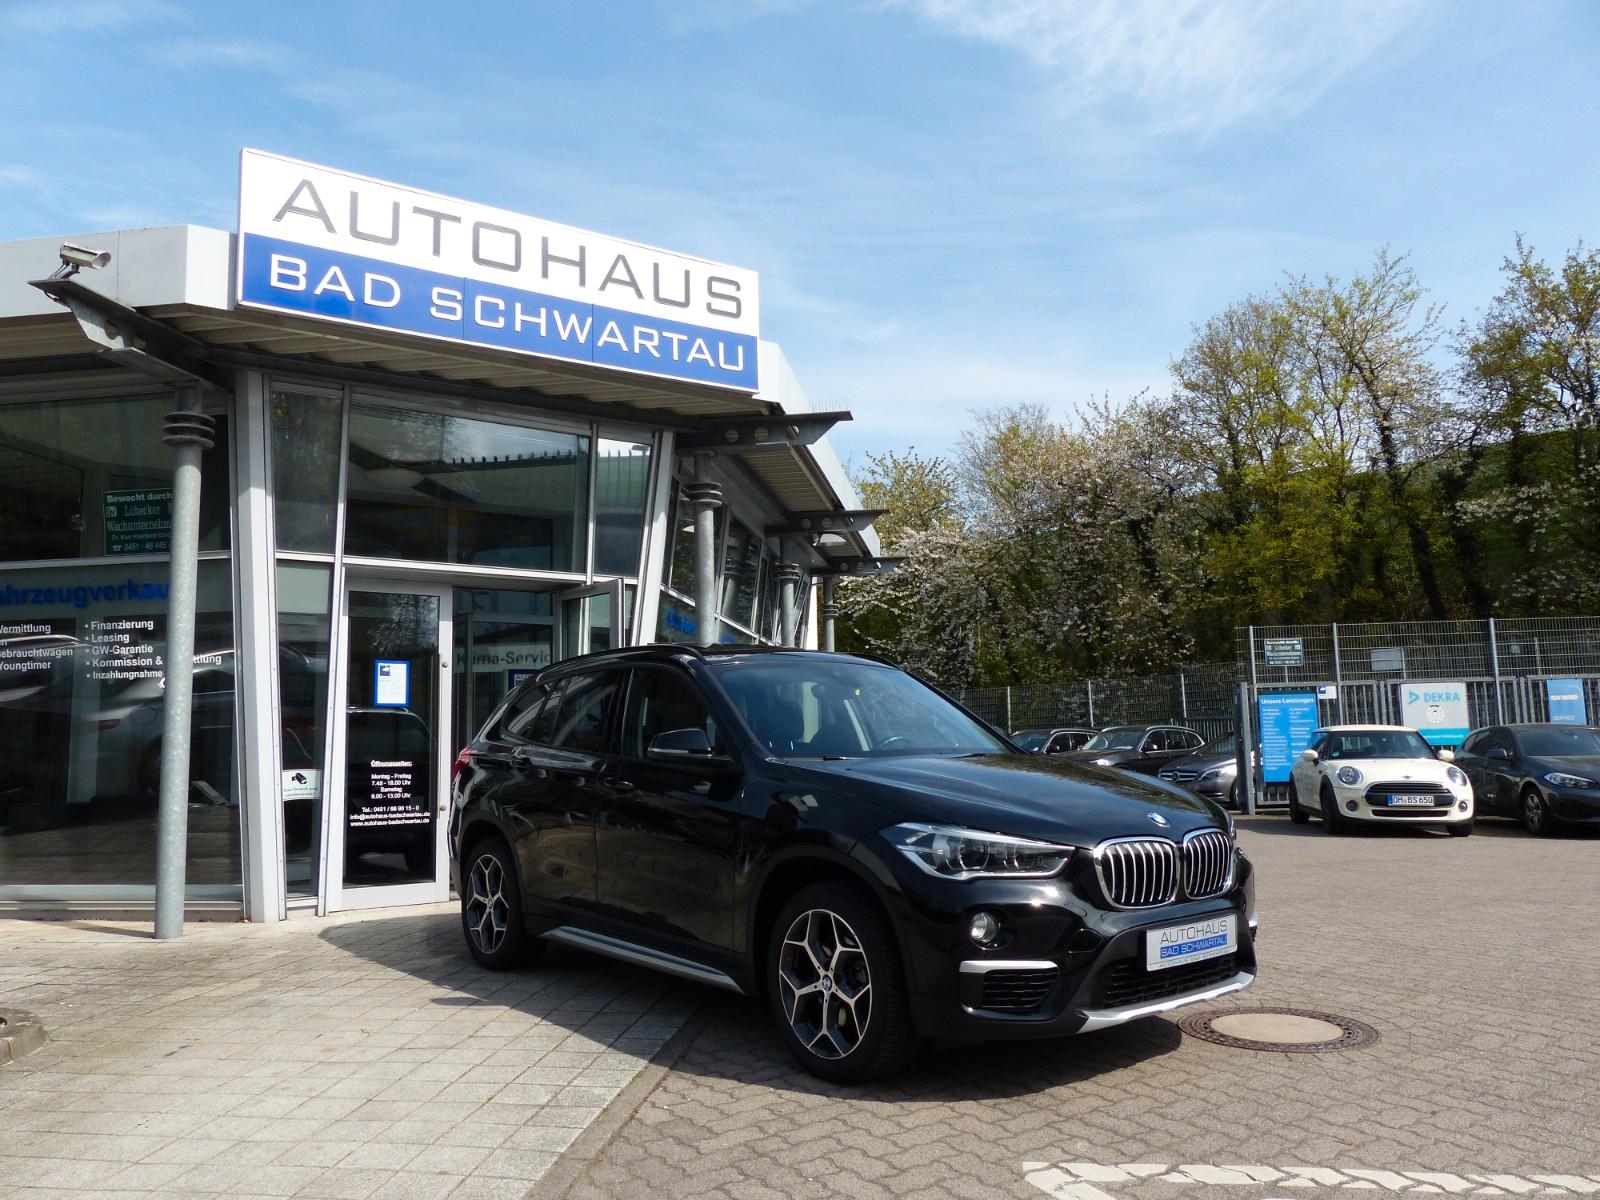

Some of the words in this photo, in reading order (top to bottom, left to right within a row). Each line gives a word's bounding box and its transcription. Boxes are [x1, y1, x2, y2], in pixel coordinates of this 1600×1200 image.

[272, 179, 742, 319] AUTOHAUS
[270, 254, 401, 309] BAD
[430, 286, 744, 372] SCHWARTAU
[106, 492, 146, 503] Bewacht
[147, 491, 173, 500] durch
[105, 518, 172, 532] Wachunternehm
[91, 620, 154, 631] Finanzierung
[91, 633, 130, 644] Leasing
[0, 647, 73, 659] ebrauchtwagen
[92, 644, 153, 656] GW-Garantie
[92, 657, 153, 668] Kommission
[155, 655, 163, 666] &
[456, 650, 550, 667] Kima-Servic
[92, 669, 163, 681] Inzahlungnahme
[1423, 692, 1461, 702] DEKRA
[1407, 796, 1418, 804] BS
[1418, 796, 1433, 804] 650
[1160, 920, 1227, 944] AUTOHAUS
[1161, 946, 1179, 957] BAD
[1181, 935, 1227, 953] SCHWARTAU
